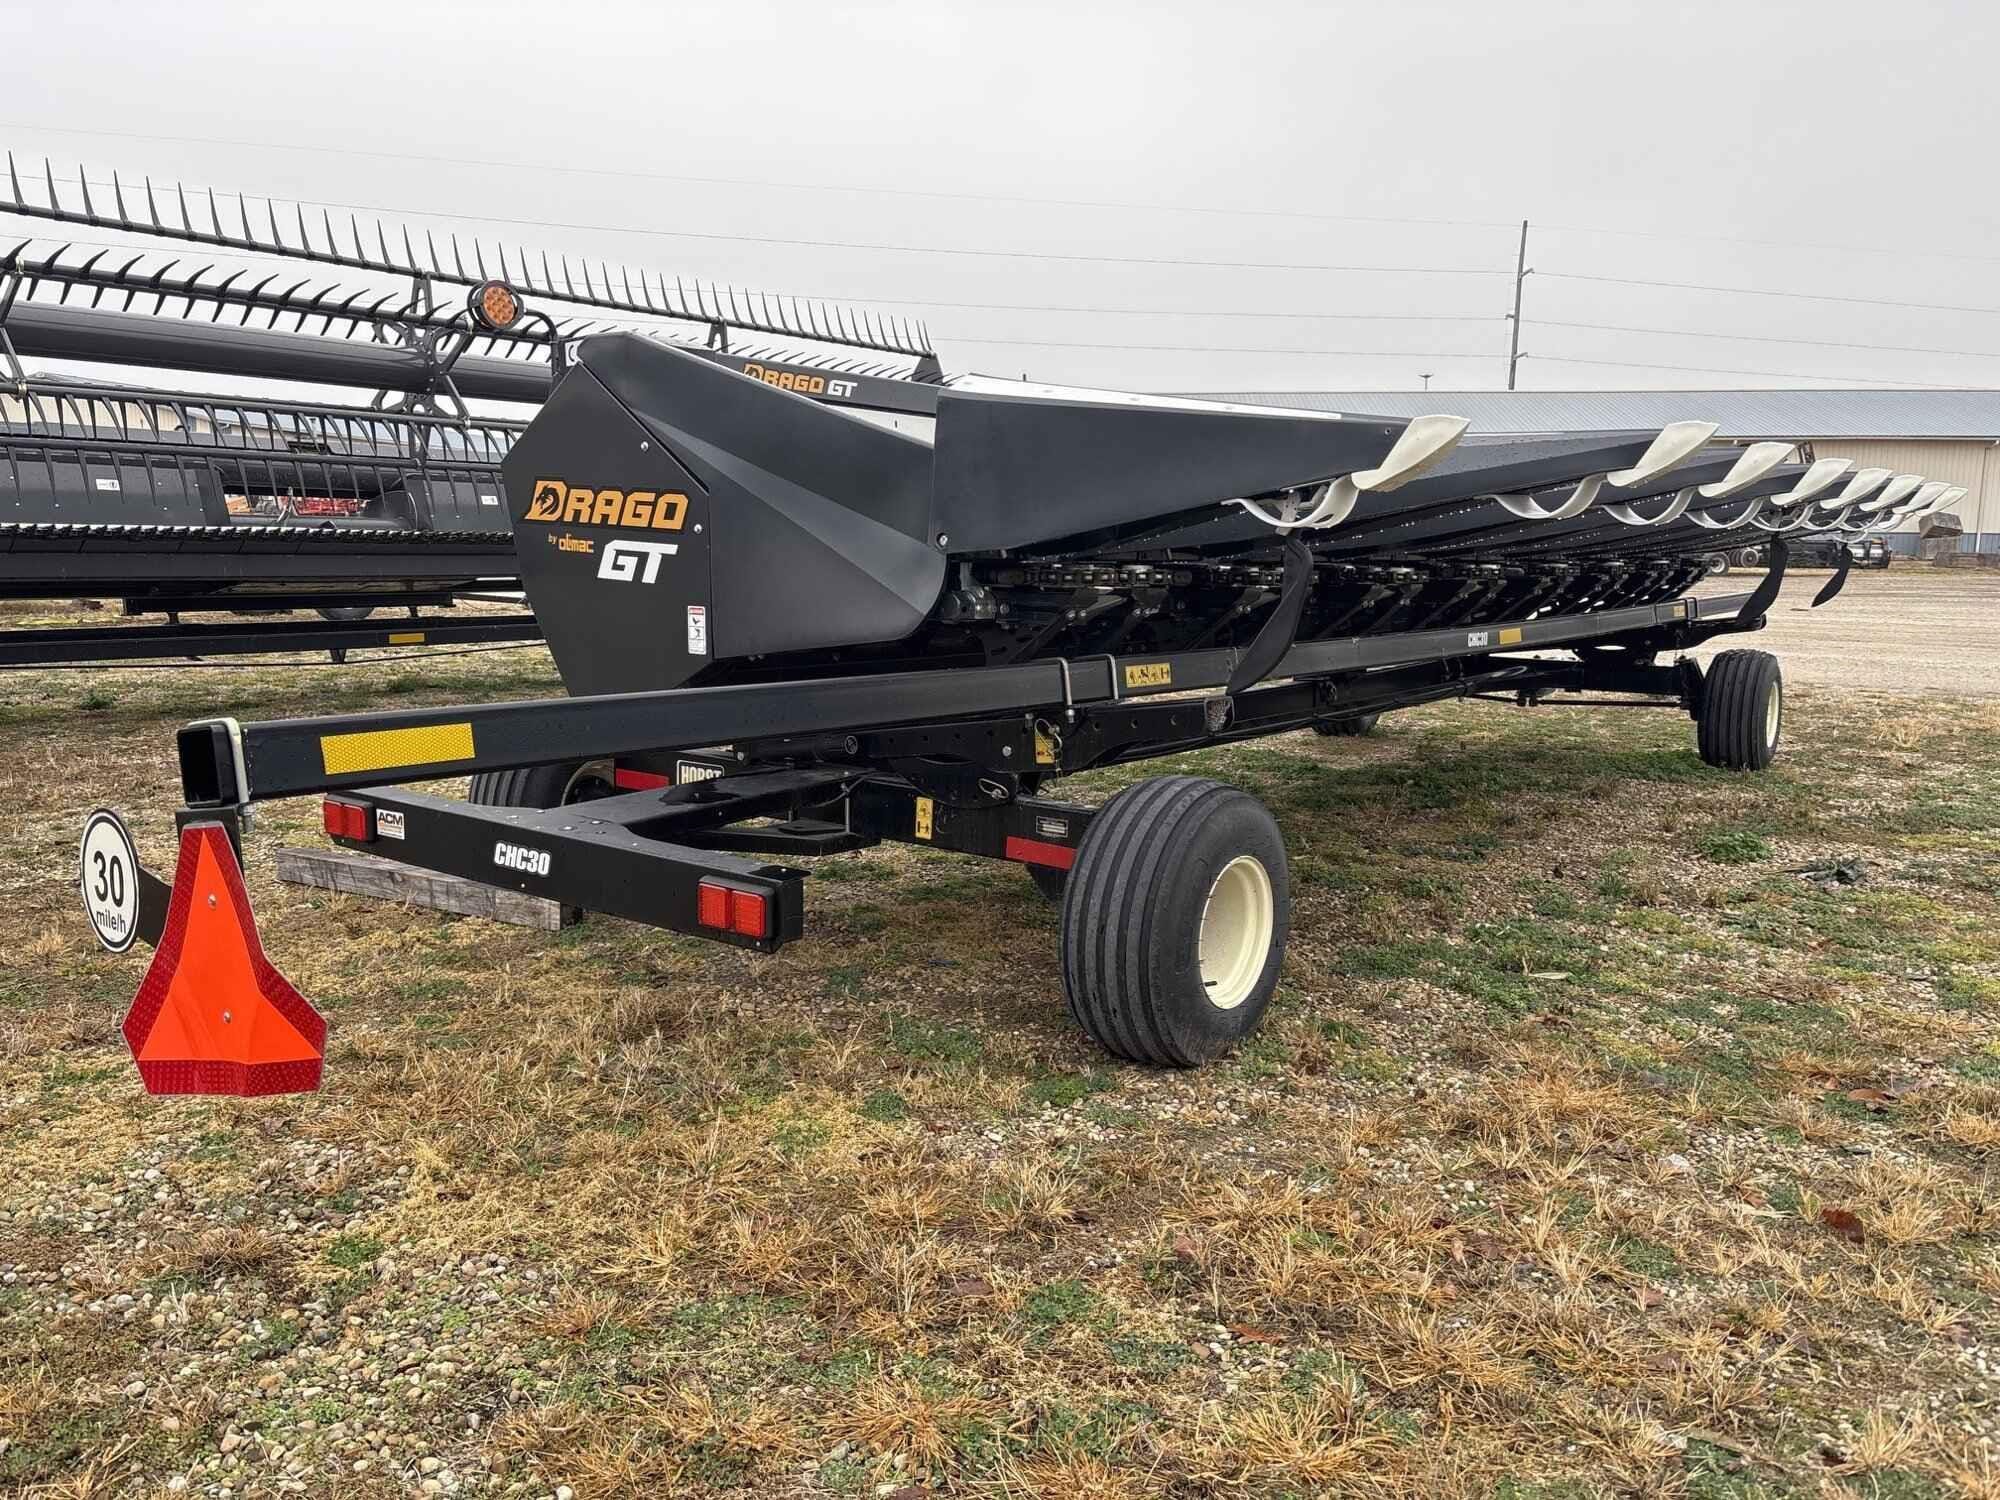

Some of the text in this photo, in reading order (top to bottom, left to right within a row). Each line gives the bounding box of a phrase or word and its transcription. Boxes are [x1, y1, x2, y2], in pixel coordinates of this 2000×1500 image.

[744, 363, 858, 397] DRAGO GT
[525, 480, 688, 529] DRAGO
[548, 533, 594, 553] by olimac
[597, 539, 678, 584] GT
[1467, 632, 1488, 647] CHC30
[378, 811, 403, 826] ACM
[494, 842, 551, 875] CHC30
[93, 850, 124, 908] 30
[96, 909, 127, 934] mile/h
